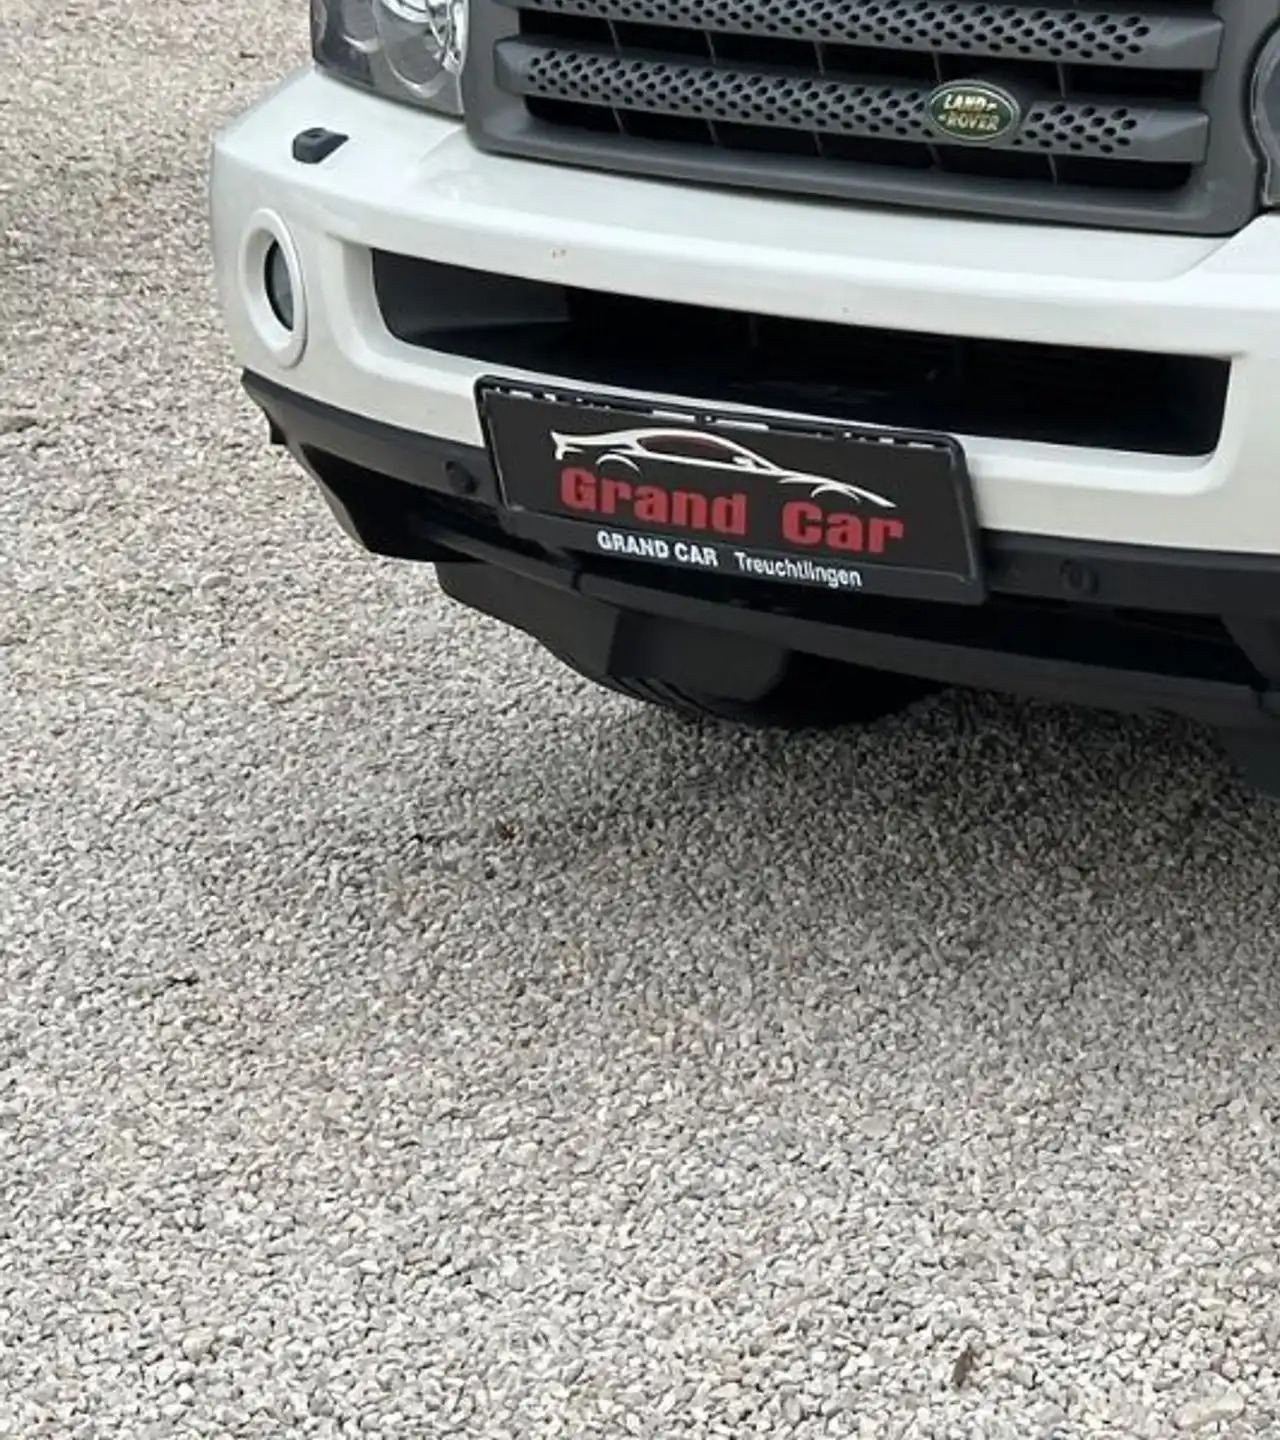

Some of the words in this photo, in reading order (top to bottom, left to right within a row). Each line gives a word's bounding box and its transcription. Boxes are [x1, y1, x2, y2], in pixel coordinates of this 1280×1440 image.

[559, 466, 747, 536] Grand
[781, 499, 905, 553] Car
[596, 530, 670, 559] GRAND
[674, 542, 719, 568] CAR
[733, 551, 863, 589] Treuchtlingen
